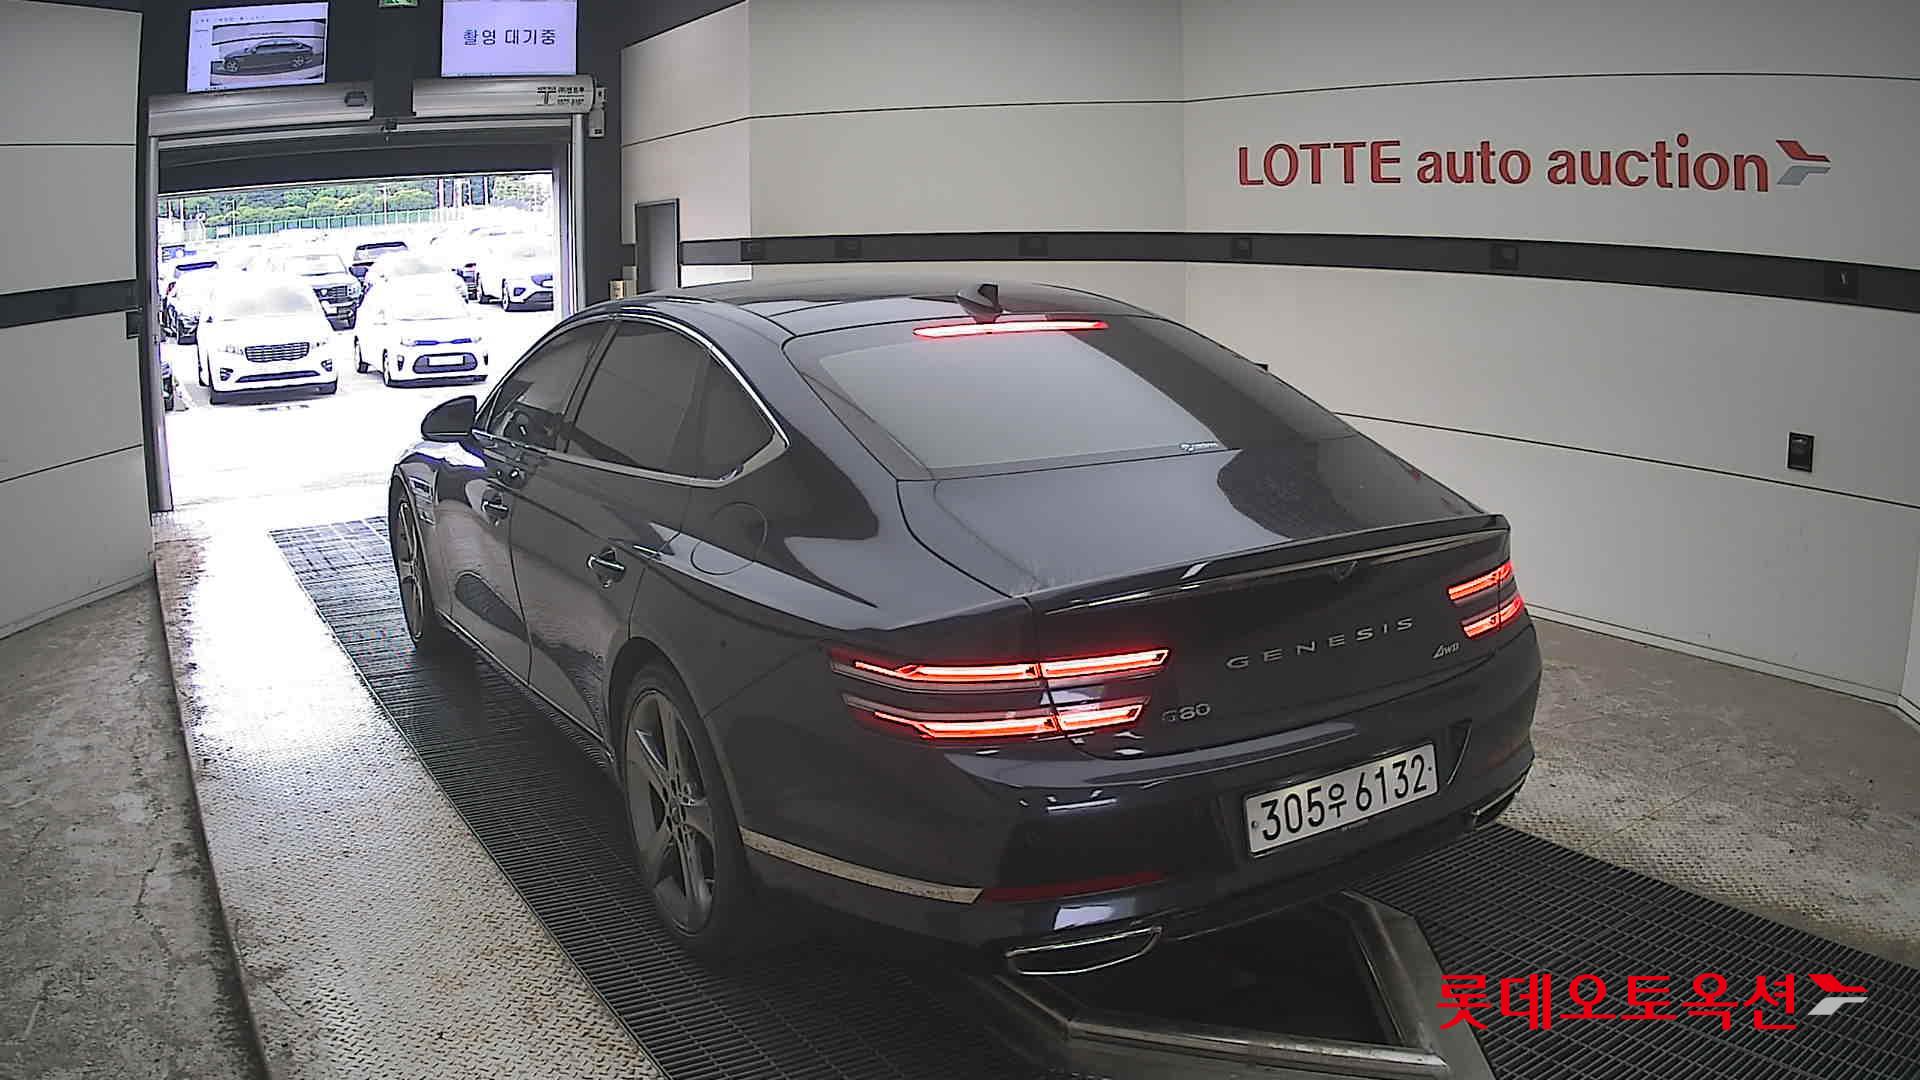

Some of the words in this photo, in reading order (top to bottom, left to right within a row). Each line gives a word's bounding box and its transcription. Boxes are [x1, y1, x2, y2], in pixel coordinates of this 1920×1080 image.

[464, 29, 496, 45] 촬영
[504, 29, 555, 45] 대기중
[1238, 140, 1401, 187] LOTTE
[1416, 141, 1531, 185] auto
[1547, 133, 1769, 192] auction
[1225, 617, 1413, 669] GENESIS
[1161, 703, 1211, 722] G80
